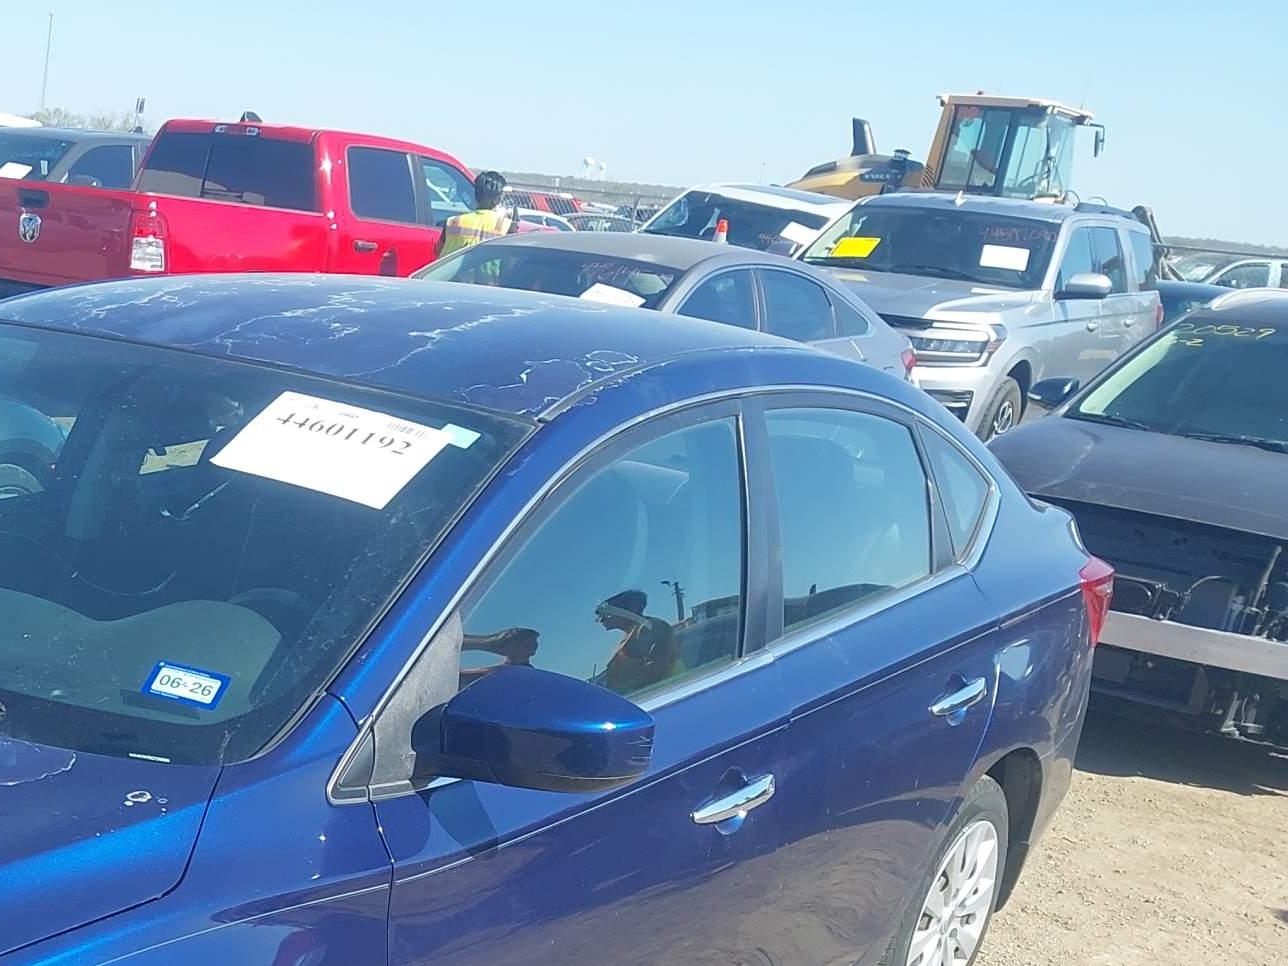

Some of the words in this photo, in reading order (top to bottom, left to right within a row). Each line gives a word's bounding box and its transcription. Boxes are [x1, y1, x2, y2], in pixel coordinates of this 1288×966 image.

[276, 412, 412, 455] 44601192
[159, 674, 182, 688] 06
[189, 682, 213, 696] 26
